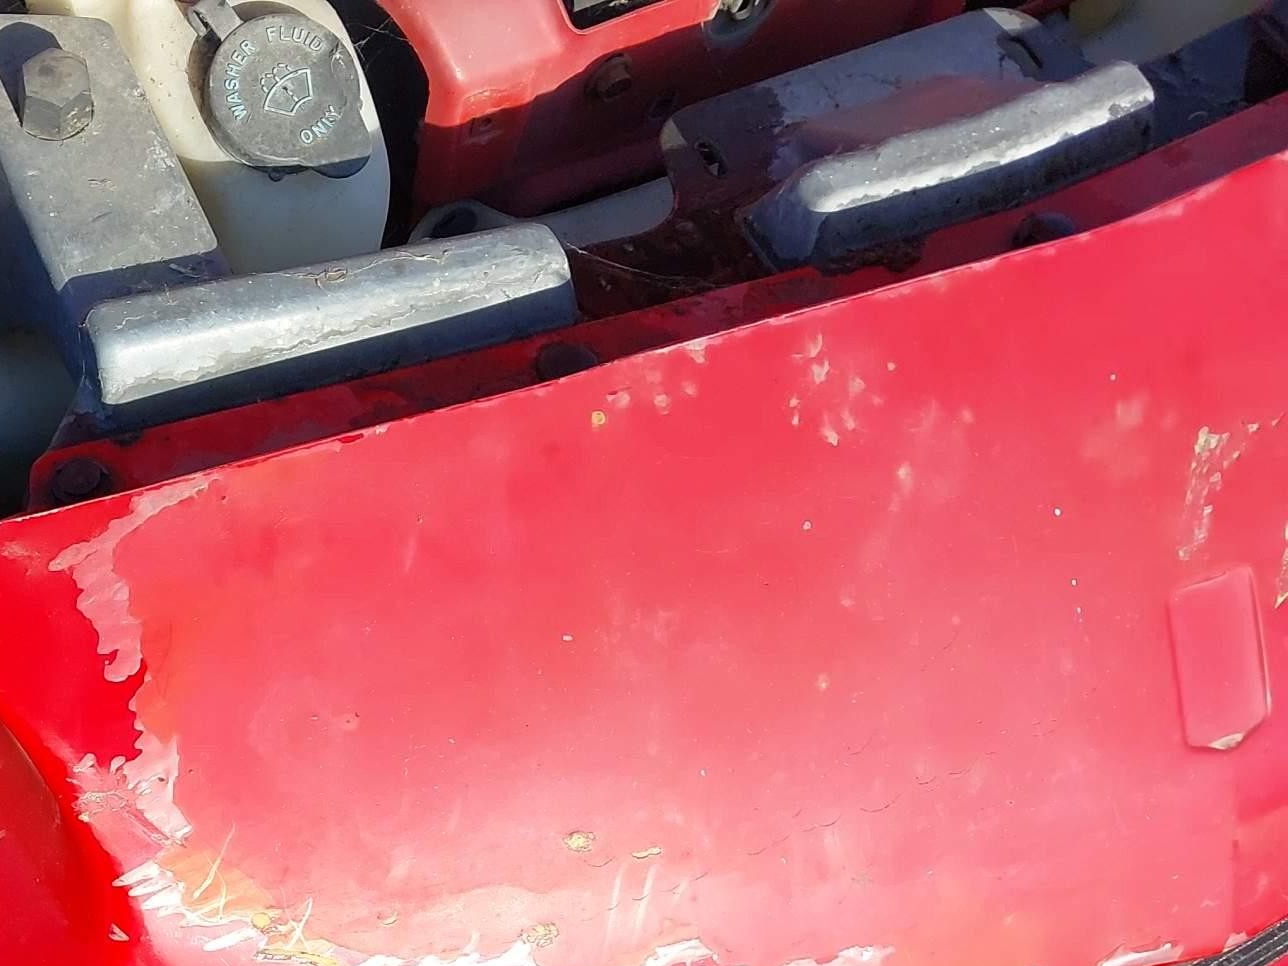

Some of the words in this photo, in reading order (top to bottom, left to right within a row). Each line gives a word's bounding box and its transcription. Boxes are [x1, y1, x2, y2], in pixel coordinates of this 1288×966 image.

[224, 40, 256, 121] WASHER
[266, 26, 323, 51] FLUID
[300, 105, 342, 144] ONLY
